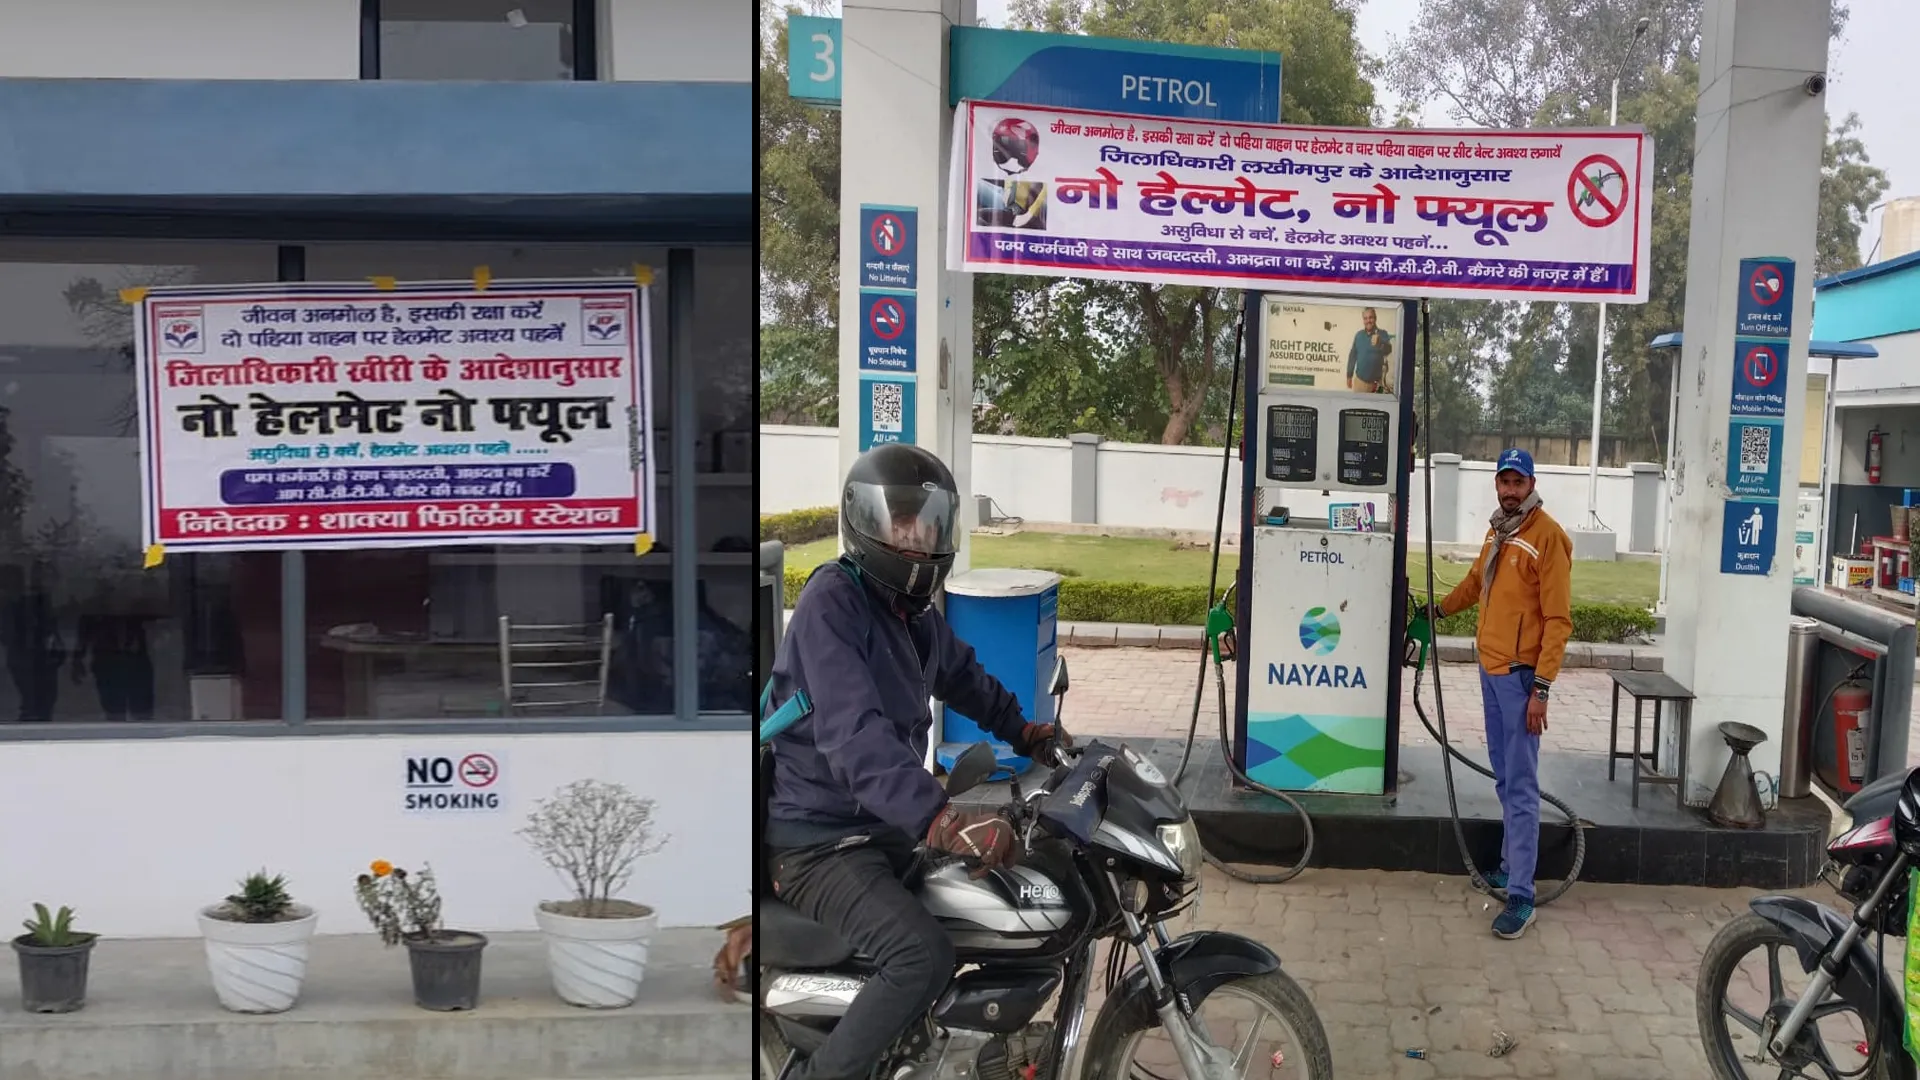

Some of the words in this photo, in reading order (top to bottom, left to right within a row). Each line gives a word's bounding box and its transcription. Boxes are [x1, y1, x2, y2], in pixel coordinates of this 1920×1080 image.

[809, 32, 836, 83] 3
[1122, 75, 1217, 108] PETROL
[1050, 123, 1081, 136] जीवन
[1083, 123, 1124, 140] अनमोल
[1142, 126, 1172, 144] इसकी
[1176, 130, 1194, 146] रक्षा
[1197, 130, 1215, 147] करें
[1219, 132, 1231, 148] दो
[1233, 132, 1263, 150] पहिया
[1265, 138, 1292, 153] वाहन
[1295, 139, 1309, 151] पर
[1345, 143, 1354, 155] व
[1356, 144, 1373, 156] चार
[1376, 139, 1405, 158] पहिया
[1408, 145, 1434, 158] वाहन
[1437, 146, 1451, 158] पर
[1453, 142, 1472, 159] सीट
[1474, 143, 1494, 159] बेल्ट
[1496, 146, 1527, 159] अवश्य
[1100, 146, 1235, 172] जिलाधिकारी
[1241, 158, 1344, 183] लखीमपुर
[1349, 163, 1374, 179] के
[1379, 164, 1512, 188] आदेशानुसार
[1055, 166, 1122, 210] नो
[1332, 183, 1400, 224] नो
[1414, 196, 1554, 246] फ्यूल
[1161, 223, 1225, 242] असुविधा
[1229, 225, 1245, 240] से
[1285, 228, 1336, 245] हेलमेट
[1339, 234, 1388, 247] अवश्य
[994, 240, 1024, 254] पम्प
[1028, 241, 1088, 258] कर्मचारी
[1092, 242, 1109, 258] के
[1113, 247, 1142, 261] साथ
[1226, 253, 1280, 269] अभद्रता
[1285, 257, 1302, 268] ना
[1340, 259, 1369, 272] आप
[1467, 263, 1507, 277] कैमरे
[1508, 264, 1528, 280] की
[1572, 267, 1587, 281] में
[880, 274, 907, 284] Littering
[241, 304, 297, 326] जीवन
[302, 303, 376, 324] अनमोल
[408, 303, 465, 324] इसकी
[471, 304, 504, 320] रक्षा
[511, 300, 544, 319] करें
[222, 329, 241, 347] दो
[248, 329, 302, 347] पहिया
[308, 330, 356, 347] वाहन
[364, 331, 387, 346] पर
[458, 328, 514, 345] अवश्य
[1741, 323, 1754, 331] Turn
[1756, 323, 1766, 332] Off
[1767, 325, 1788, 334] Engine
[1269, 339, 1302, 350] RIGHT
[1269, 352, 1304, 361] ASSURED
[166, 355, 339, 387] जिलाधिकारी
[345, 355, 413, 383] खीरी
[420, 353, 450, 381] के
[460, 353, 623, 387] आदेशानुसार
[868, 357, 878, 365] No
[879, 358, 907, 368] Smoking
[176, 394, 239, 438] नो
[248, 391, 407, 436] हेलमेट
[416, 389, 477, 432] नो
[489, 396, 614, 443] फ्यूल
[1732, 404, 1740, 412] No
[1742, 404, 1761, 412] Mobile
[1763, 405, 1784, 414] Phones
[873, 433, 883, 443] All
[177, 511, 290, 534] निवेदक
[417, 504, 524, 529] फिलिंग
[532, 503, 621, 525] स्टेशन
[1300, 551, 1344, 564] PETROL
[1736, 563, 1760, 571] Dustbin
[1268, 663, 1367, 689] NAYARA
[407, 757, 453, 783] NO
[405, 793, 499, 809] SMOKING
